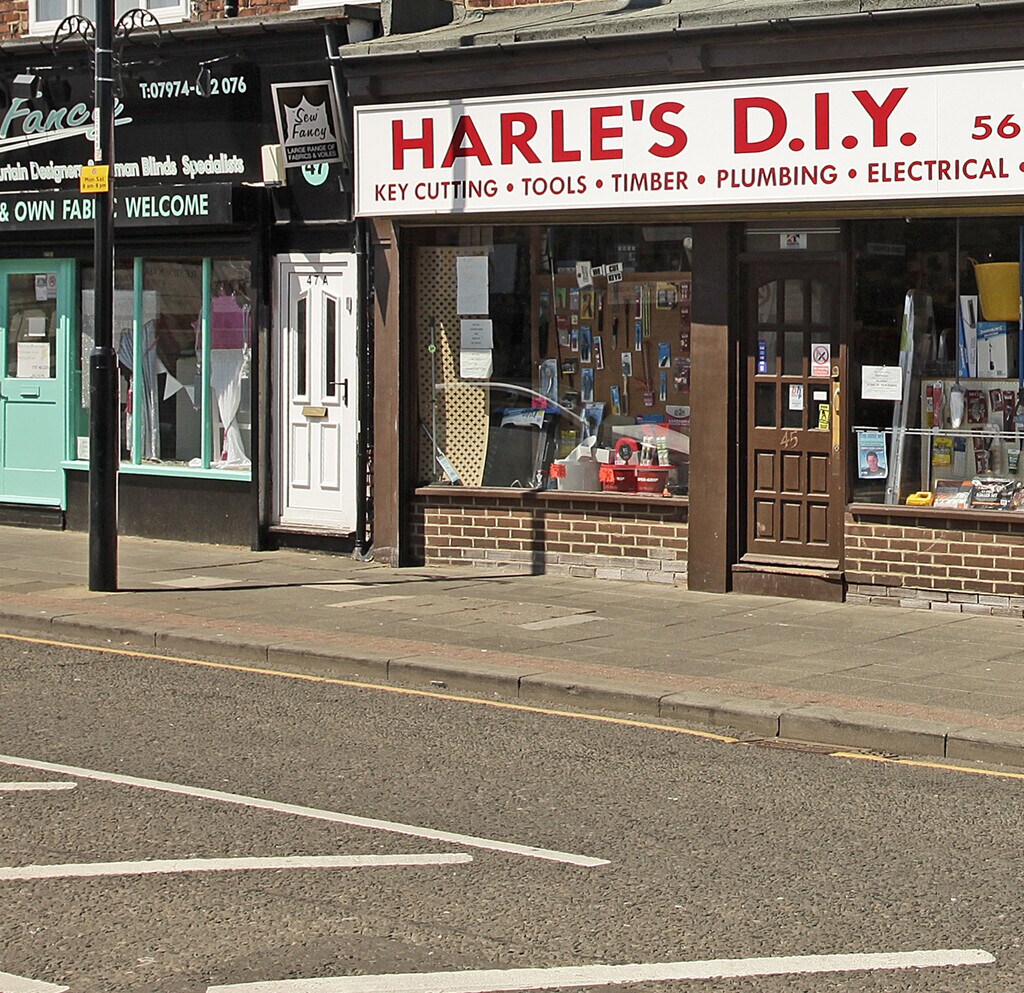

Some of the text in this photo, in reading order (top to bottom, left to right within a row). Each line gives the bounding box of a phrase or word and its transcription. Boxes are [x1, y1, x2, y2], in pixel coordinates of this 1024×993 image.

[294, 107, 318, 123] Sew
[292, 123, 327, 140] Fancy
[392, 87, 917, 170] HARLE'S D.I.Y.
[287, 143, 335, 154] LARGE RANGE OF
[288, 153, 312, 161] FABRICS
[317, 151, 337, 159] VOILES
[30, 160, 82, 183] Designer
[141, 155, 178, 177] Blinds
[182, 153, 245, 179] Specialists
[375, 182, 409, 201] KEY
[415, 179, 498, 199] CUTTING
[522, 175, 587, 196] TOOLS
[611, 171, 689, 193] TIMBER
[717, 164, 838, 189] PLUMBING
[868, 158, 1009, 183] ELECTRICAL
[14, 200, 55, 221] OWN
[125, 193, 209, 218] WELCOME
[608, 273, 622, 282] KEYS
[779, 430, 799, 449] 45
